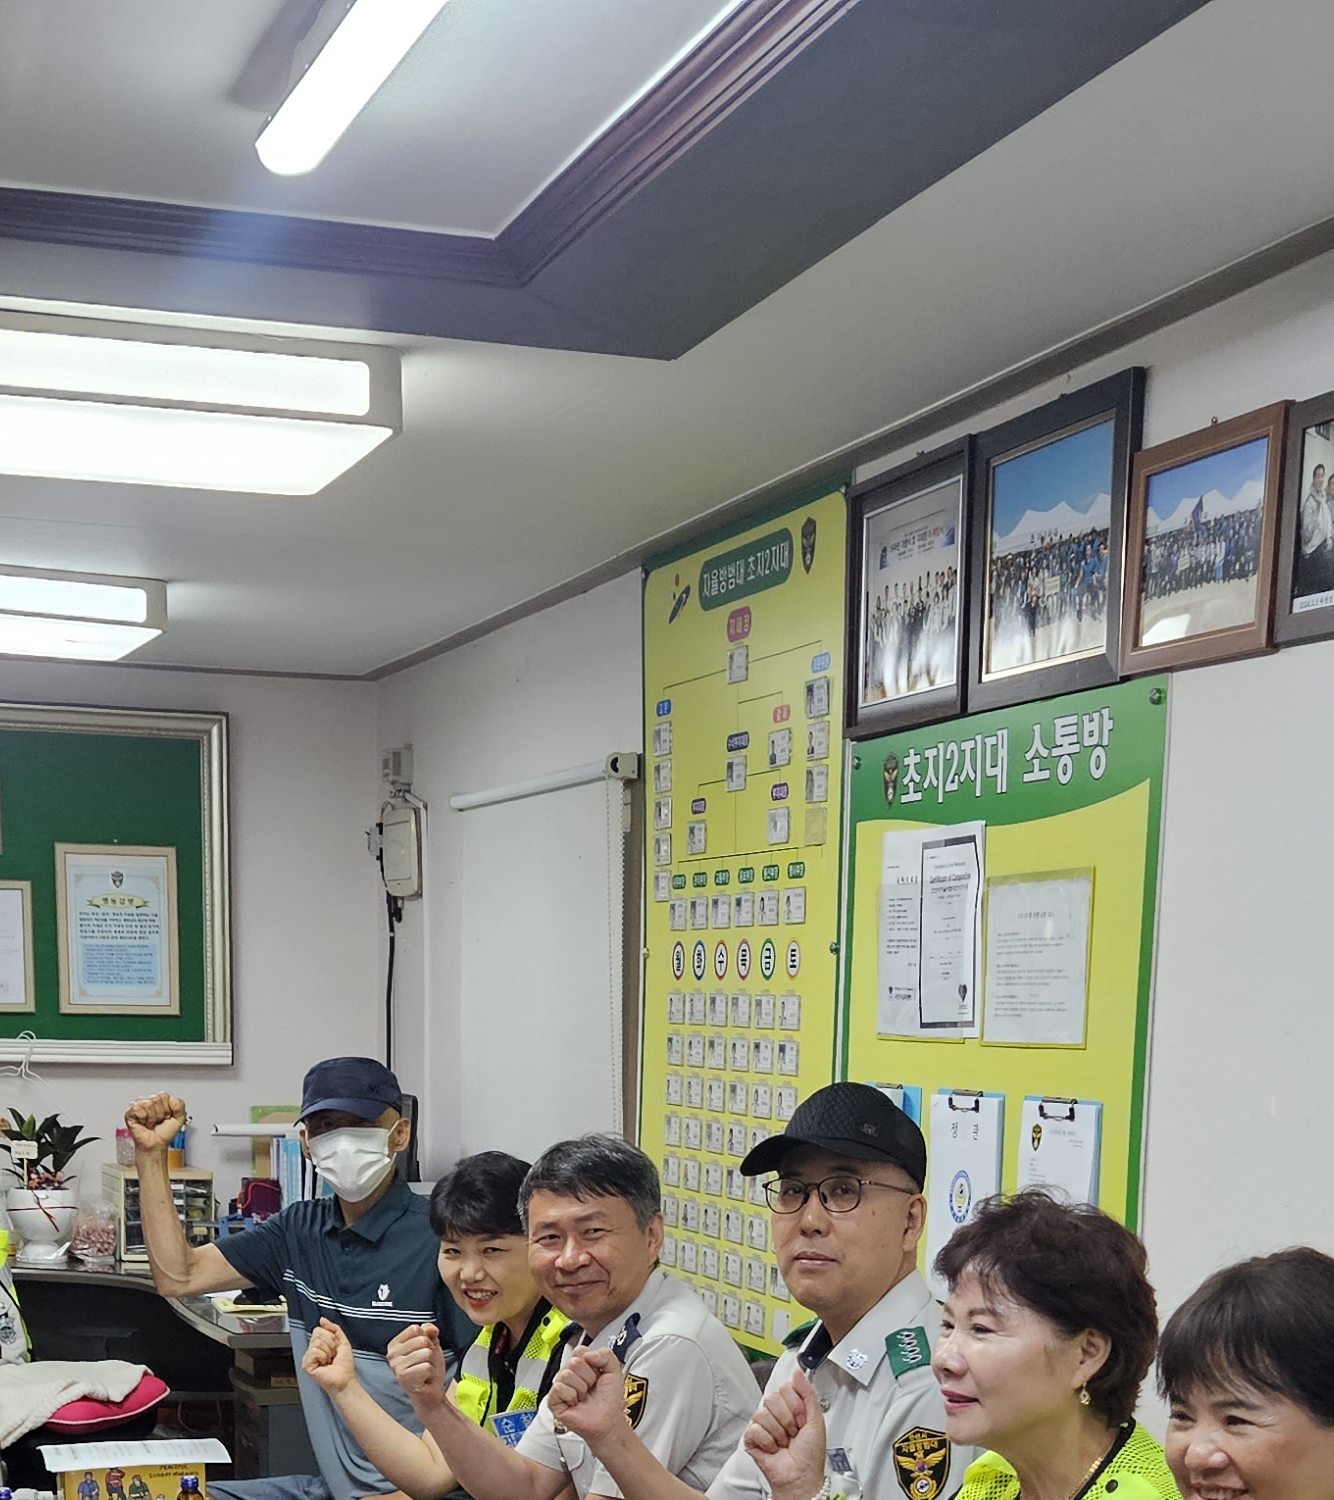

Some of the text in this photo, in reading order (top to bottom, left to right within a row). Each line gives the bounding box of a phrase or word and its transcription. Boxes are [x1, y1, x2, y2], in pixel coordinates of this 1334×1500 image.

[702, 541, 789, 598] 자율방범대 초지2지대
[900, 706, 1114, 804] 초지2지대 소통방
